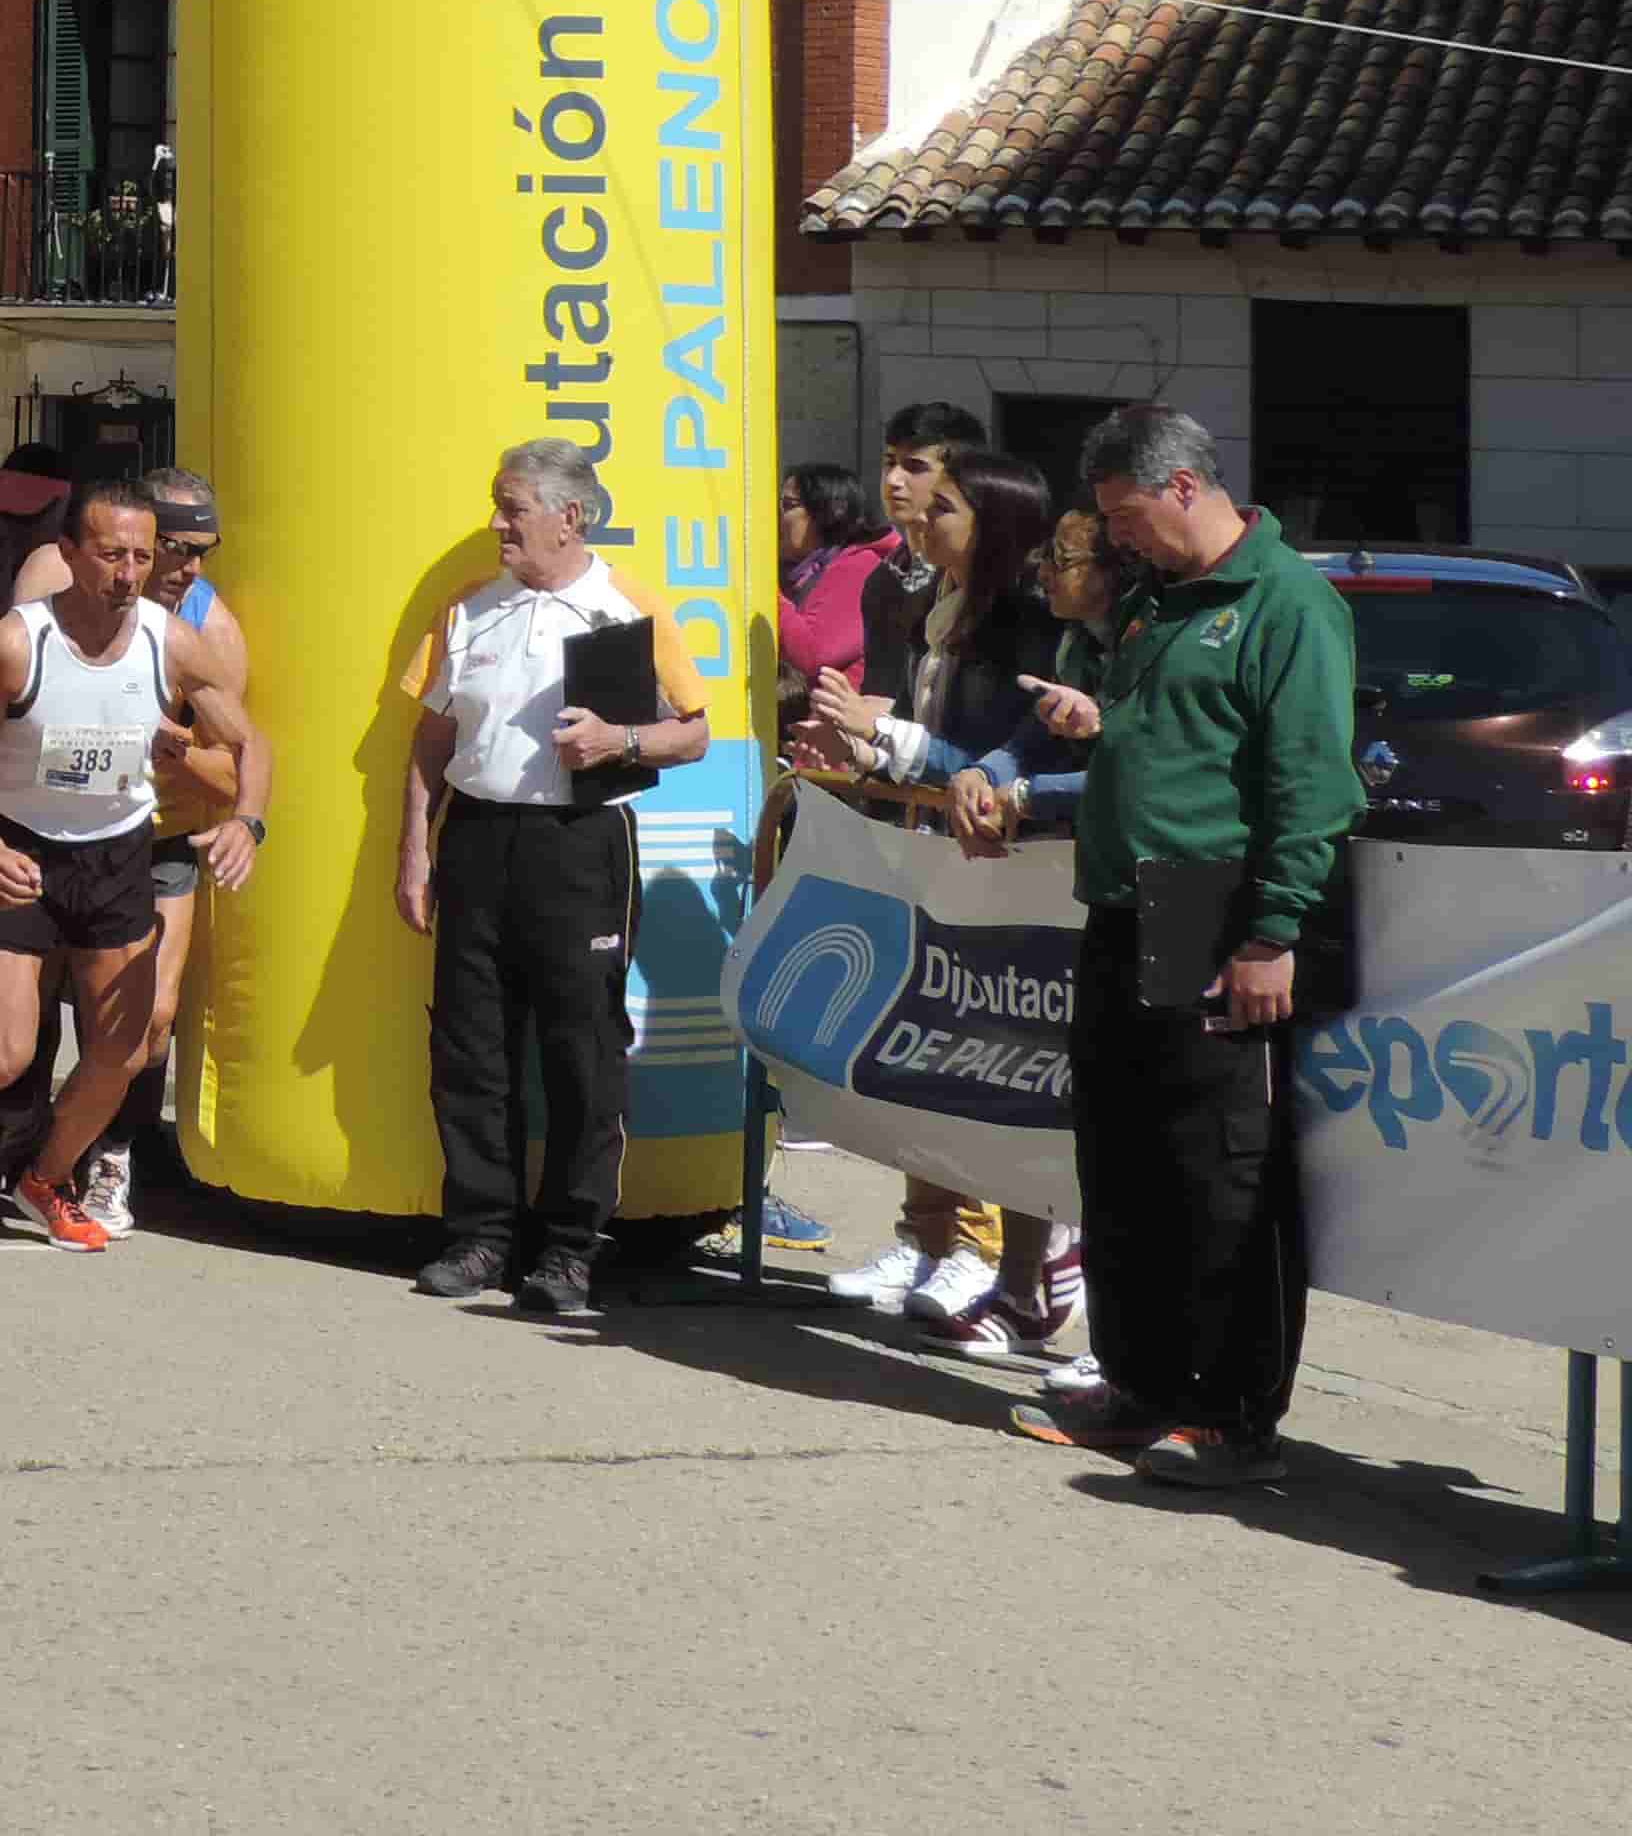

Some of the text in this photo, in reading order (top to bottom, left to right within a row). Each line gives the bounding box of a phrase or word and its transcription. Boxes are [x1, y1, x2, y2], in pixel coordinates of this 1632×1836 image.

[664, 515, 731, 678] DE
[69, 749, 113, 772] 383
[919, 943, 1075, 1025] Diputaci
[876, 1019, 1074, 1099] DE PALEN
[1294, 1000, 1632, 1153] eport
